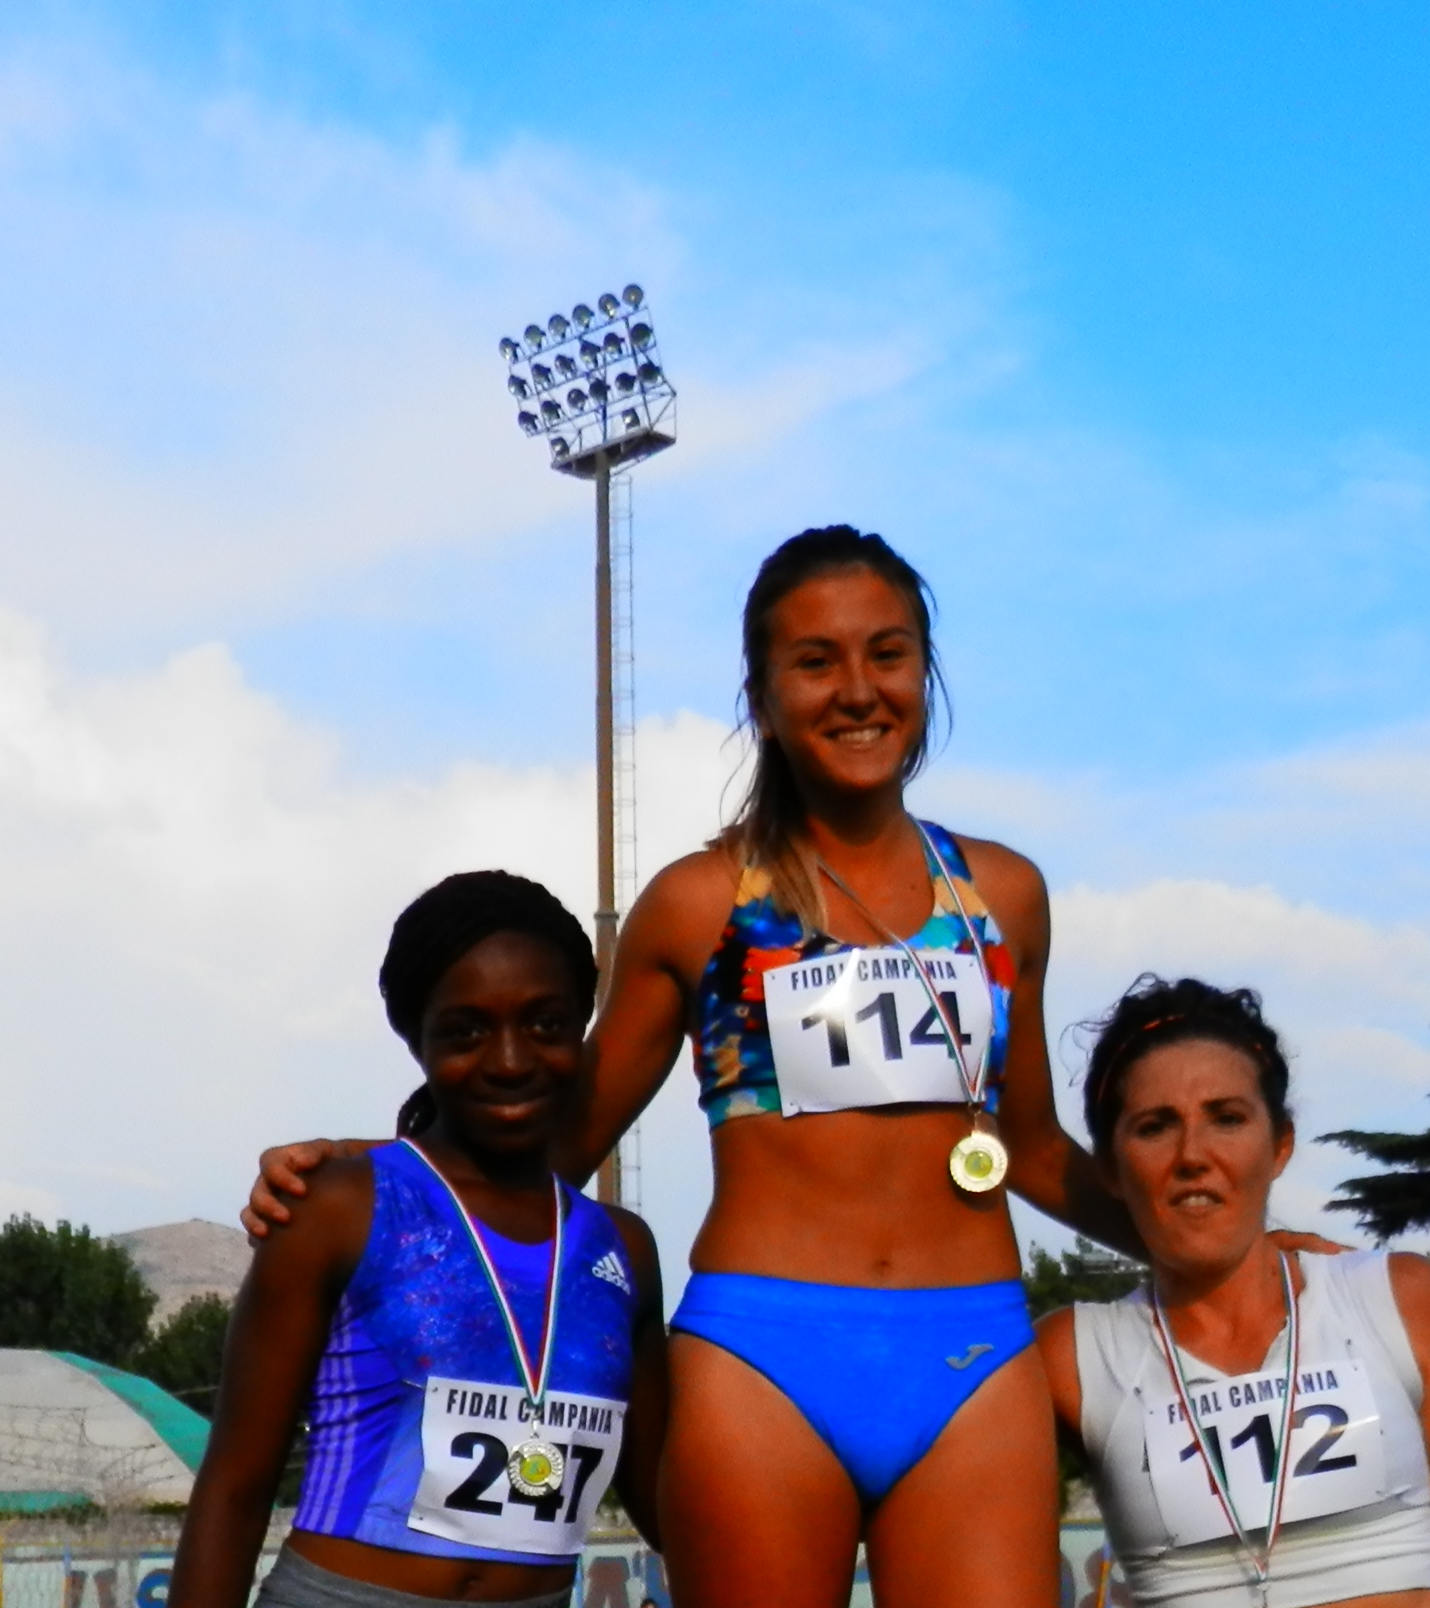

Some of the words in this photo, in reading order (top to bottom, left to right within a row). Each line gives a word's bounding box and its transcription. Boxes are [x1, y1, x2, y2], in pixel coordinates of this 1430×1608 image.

[791, 962, 845, 991] FIDA
[857, 957, 958, 982] CAMPNIA
[801, 991, 972, 1068] 114
[446, 1388, 509, 1421] FIDAL
[444, 1431, 605, 1524] 247
[1179, 1402, 1357, 1496] 112
